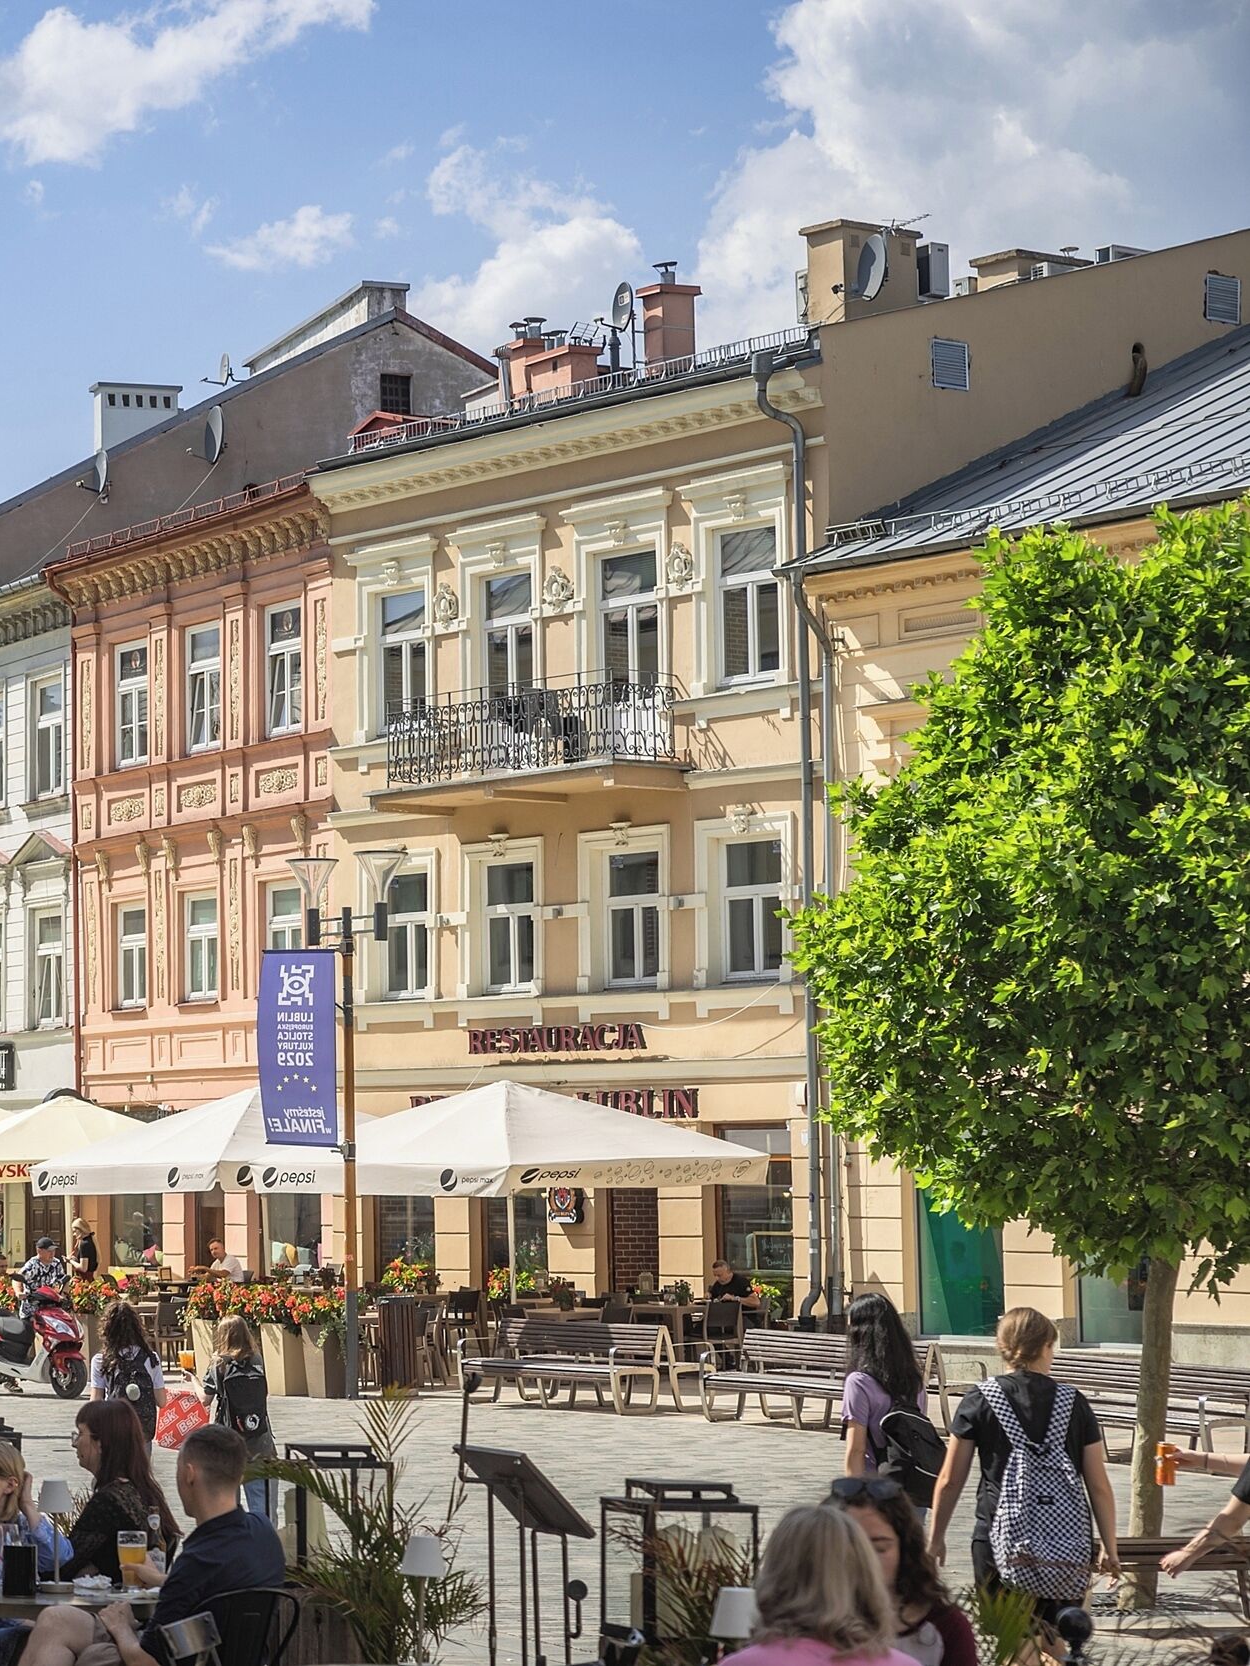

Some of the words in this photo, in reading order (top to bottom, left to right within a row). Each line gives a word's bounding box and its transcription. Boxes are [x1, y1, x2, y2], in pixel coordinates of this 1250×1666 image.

[468, 1023, 648, 1055] RESTAURACJA
[51, 1172, 78, 1189] pepsi
[279, 1169, 316, 1187] pepsi
[461, 1176, 479, 1184] pepsi
[480, 1176, 494, 1184] max
[538, 1168, 582, 1181] pepsi
